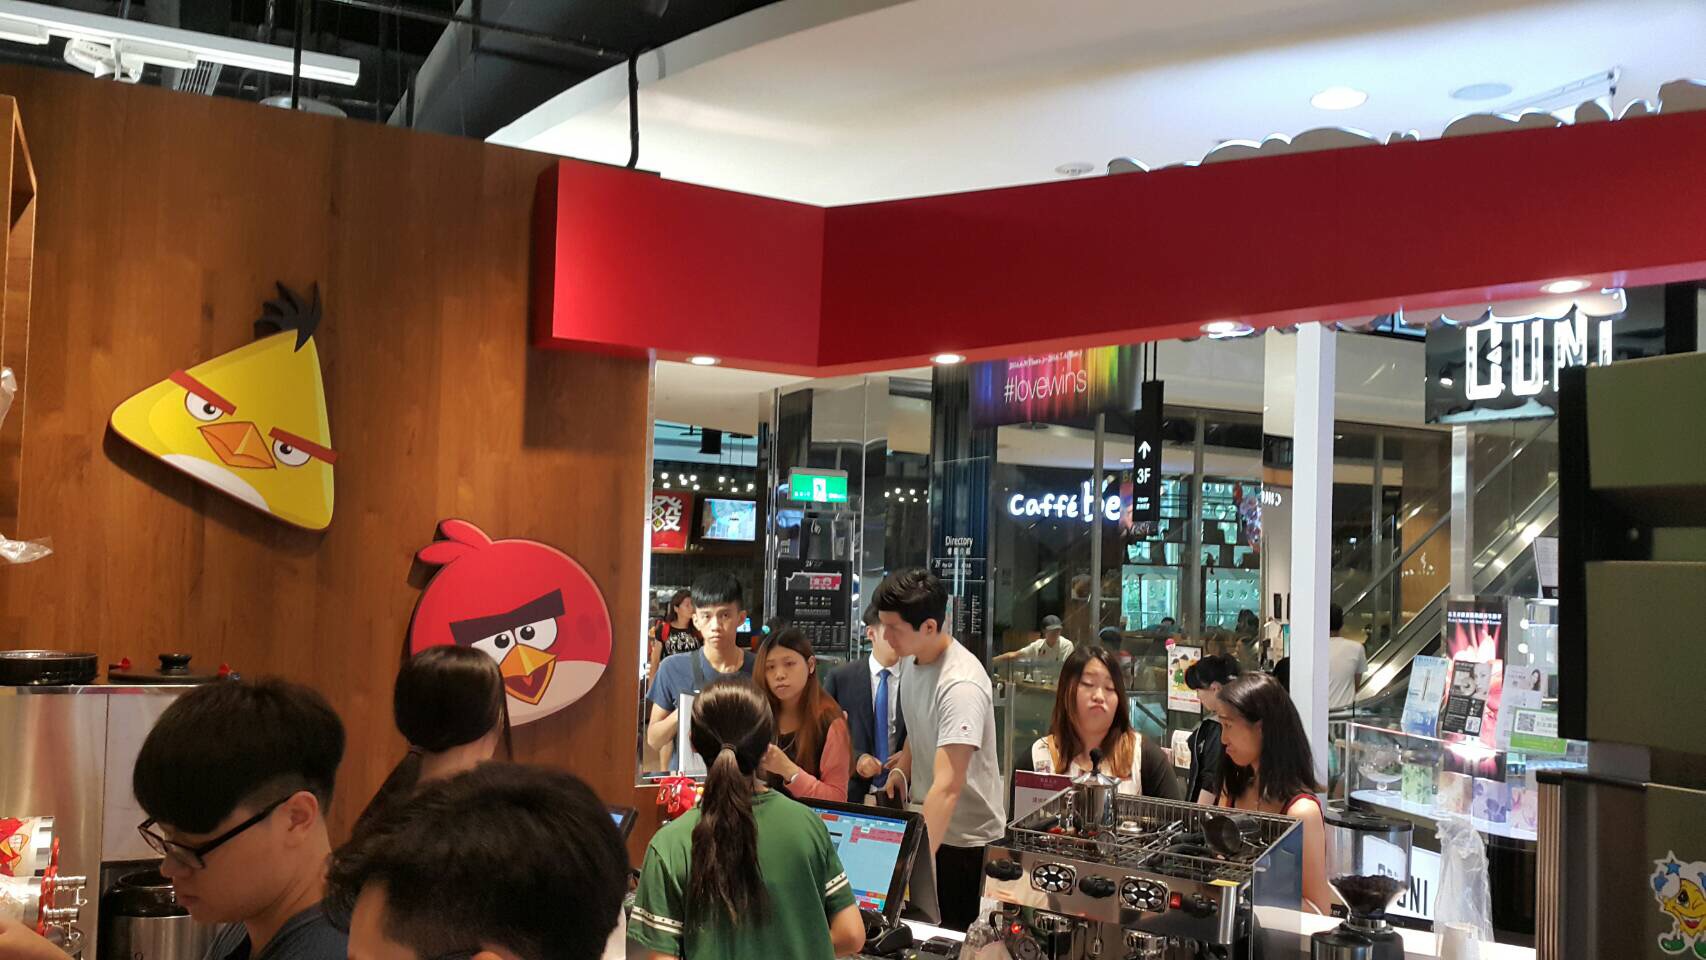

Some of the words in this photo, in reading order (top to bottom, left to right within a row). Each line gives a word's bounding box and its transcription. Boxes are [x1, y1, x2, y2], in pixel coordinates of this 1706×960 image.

[1004, 370, 1087, 403] #lovewins
[1136, 468, 1151, 484] 3F
[945, 535, 974, 548] Directory
